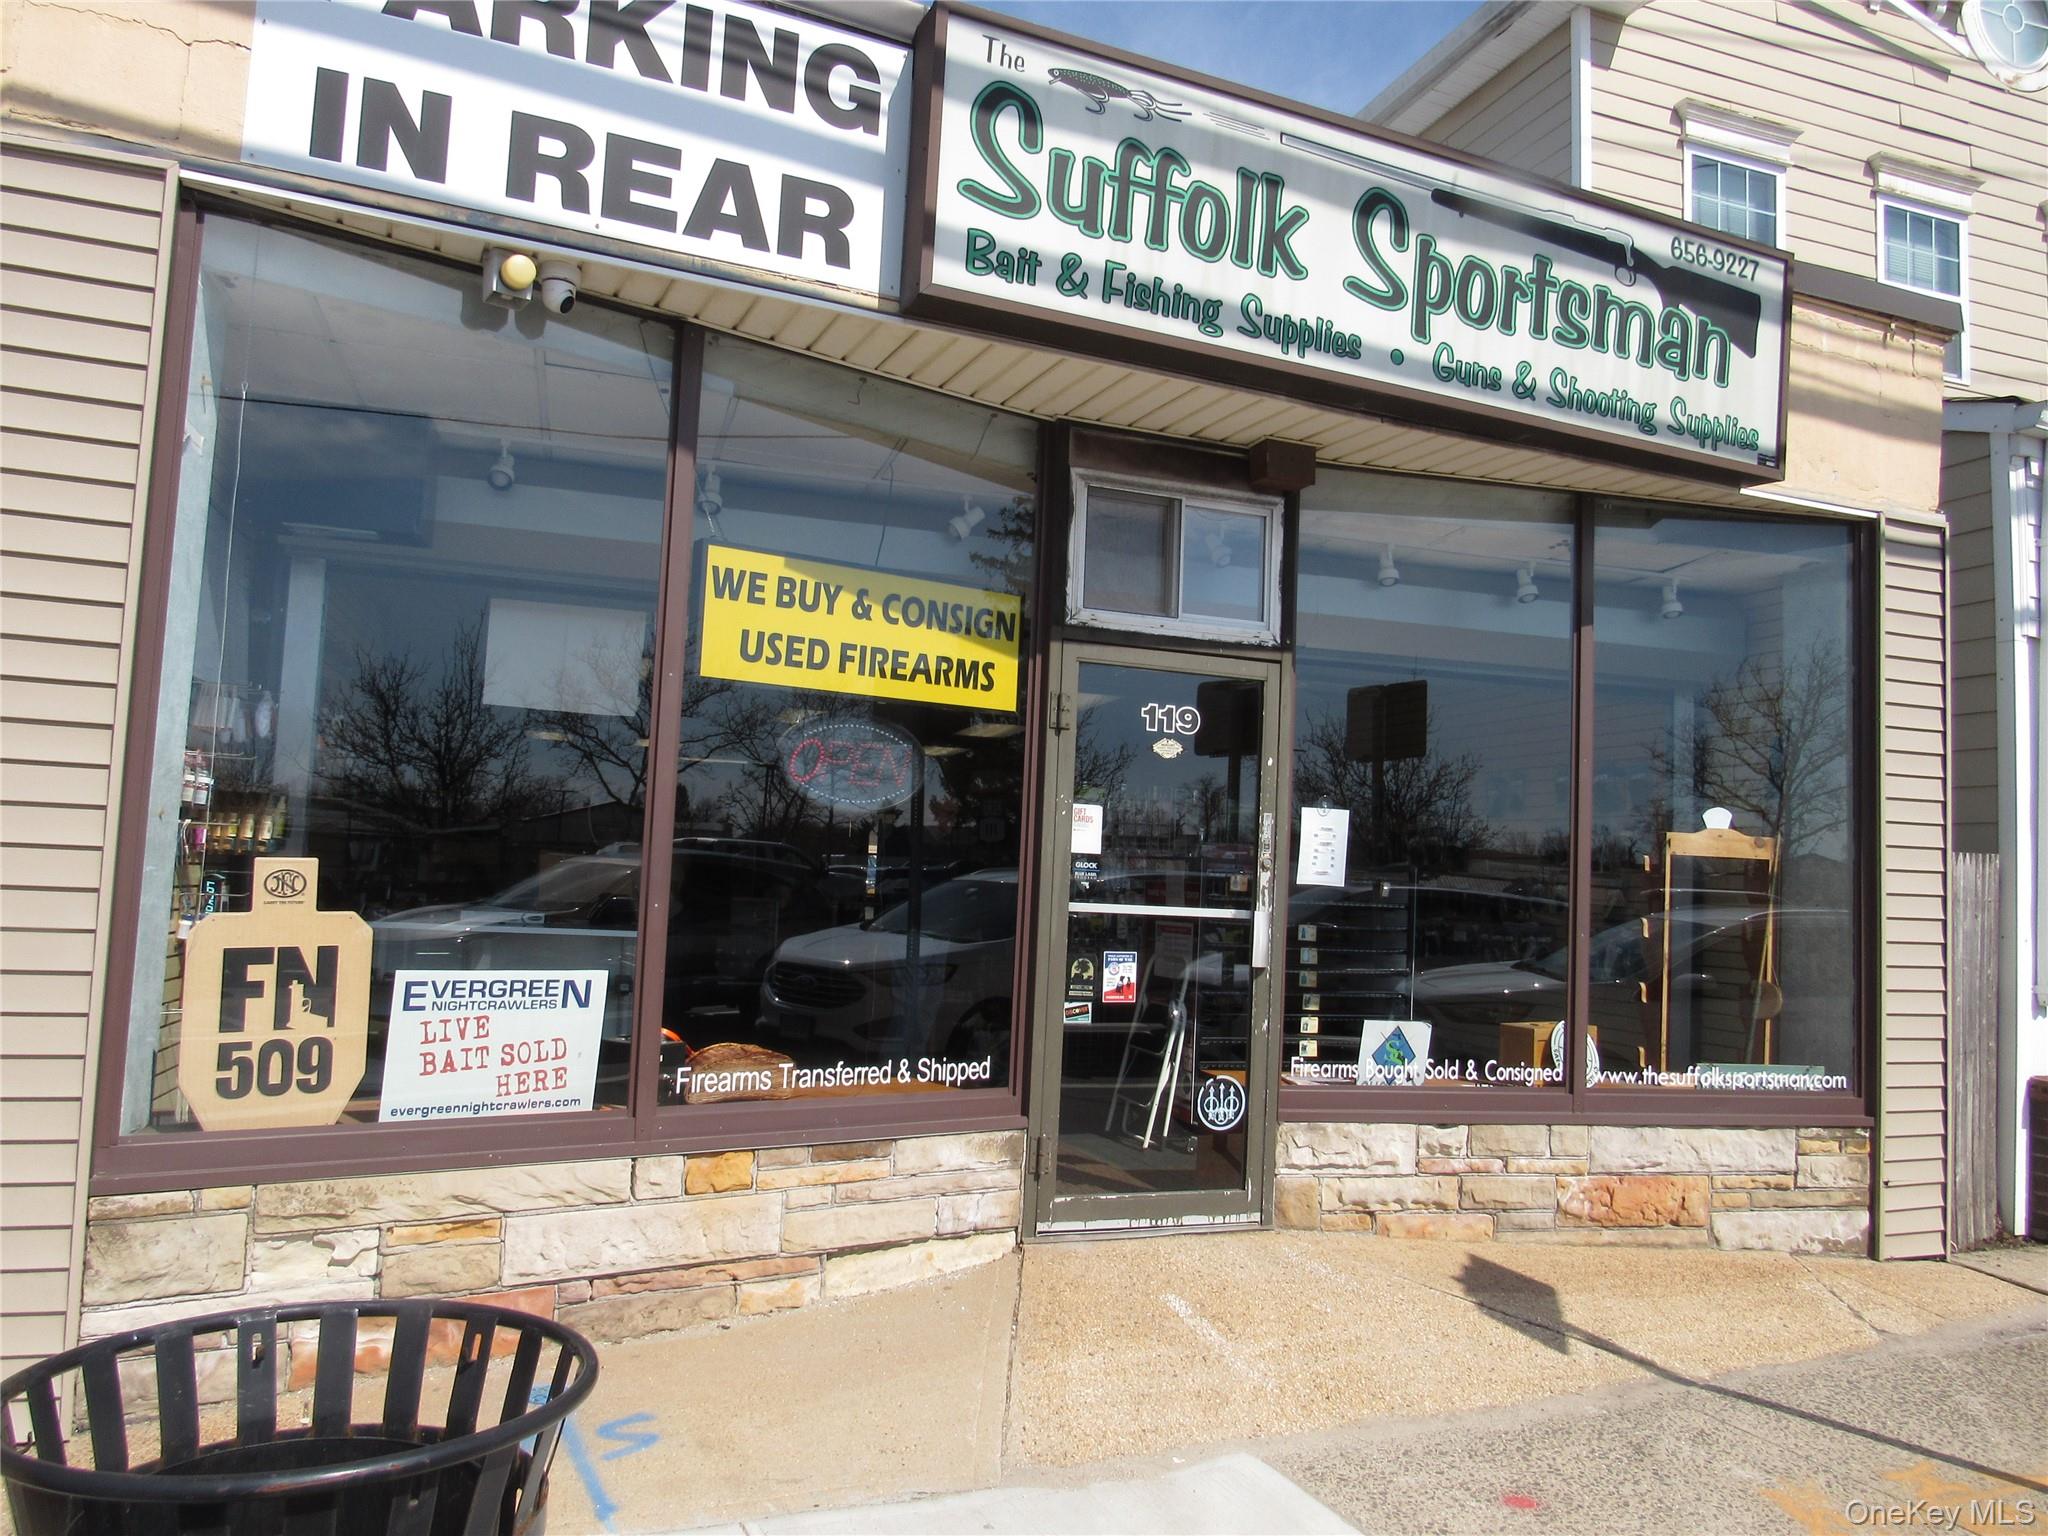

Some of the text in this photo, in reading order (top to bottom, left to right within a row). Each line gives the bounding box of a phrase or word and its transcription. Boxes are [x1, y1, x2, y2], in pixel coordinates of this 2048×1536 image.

[981, 33, 1026, 74] The
[308, 66, 855, 271] IN REAR
[956, 80, 1733, 389] Suffolk Sportsman
[1669, 235, 1761, 283] 656-9227
[964, 228, 1761, 452] Bait & Fishing Supplies Guns & Shooting Supplies
[711, 565, 1017, 642] WE BUY & CONSIGN
[738, 628, 997, 692] USED FIREARMS
[1140, 702, 1201, 736] 119
[788, 737, 912, 788] OPEN
[1075, 861, 1098, 869] GLOCK
[218, 945, 340, 1034] FN
[402, 979, 593, 1012] EVERGREEN
[431, 998, 558, 1012] NIGHTCRAWLERS
[420, 1015, 491, 1045] LIVE
[215, 1036, 334, 1100] 509
[419, 1037, 568, 1076] BAIT SOLD
[675, 1056, 991, 1095] Firearms Transferred & Shipped
[1290, 1056, 1359, 1079] Firearms
[1425, 1059, 1459, 1081] Sold
[1465, 1059, 1479, 1081] &
[1484, 1059, 1563, 1087] Consigned
[496, 1067, 569, 1098] HERE
[1595, 1065, 1847, 1090] www.thesuffolksportsman.com
[390, 1096, 582, 1117] evergreennightcrawlers.com
